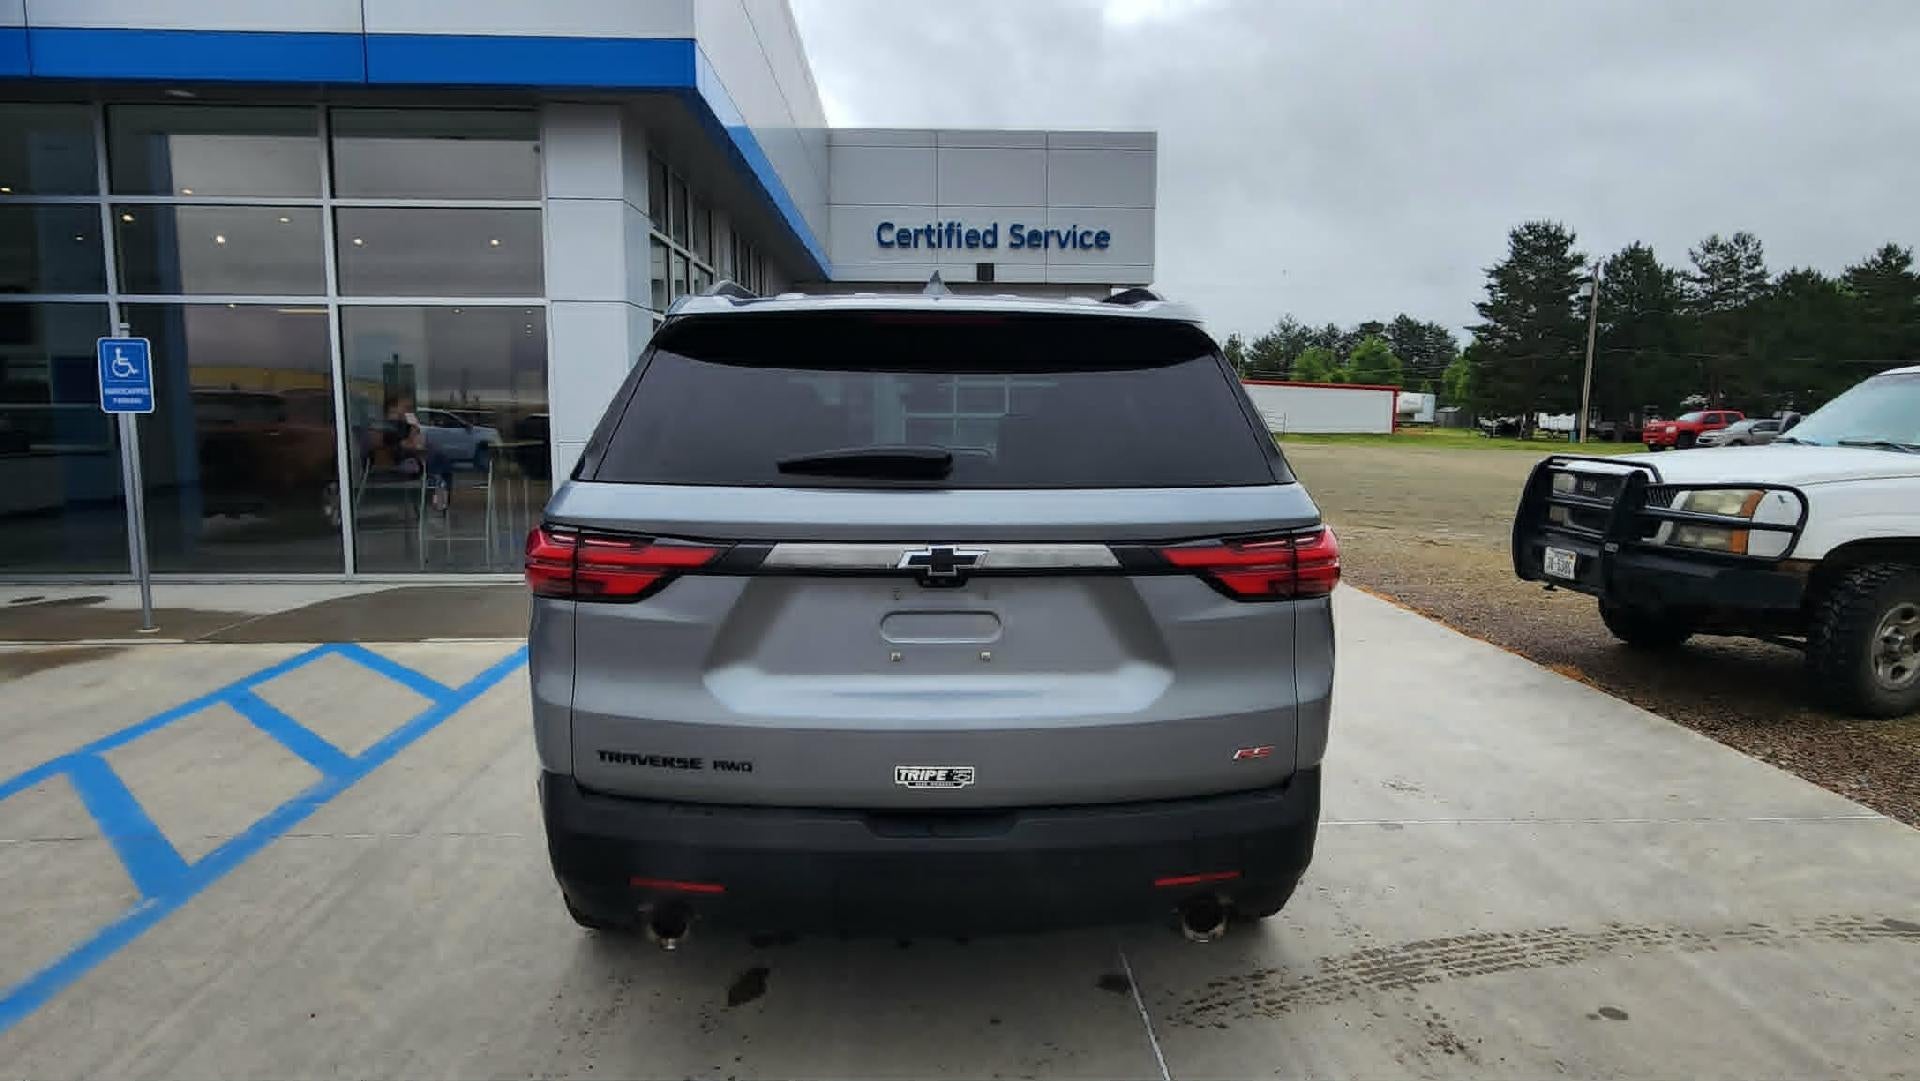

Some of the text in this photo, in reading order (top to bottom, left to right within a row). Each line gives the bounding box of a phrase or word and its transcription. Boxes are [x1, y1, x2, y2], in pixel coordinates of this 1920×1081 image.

[876, 222, 1111, 249] Certified Service
[598, 750, 753, 773] TRAVERSE AWD
[900, 769, 948, 781] TRIPE
